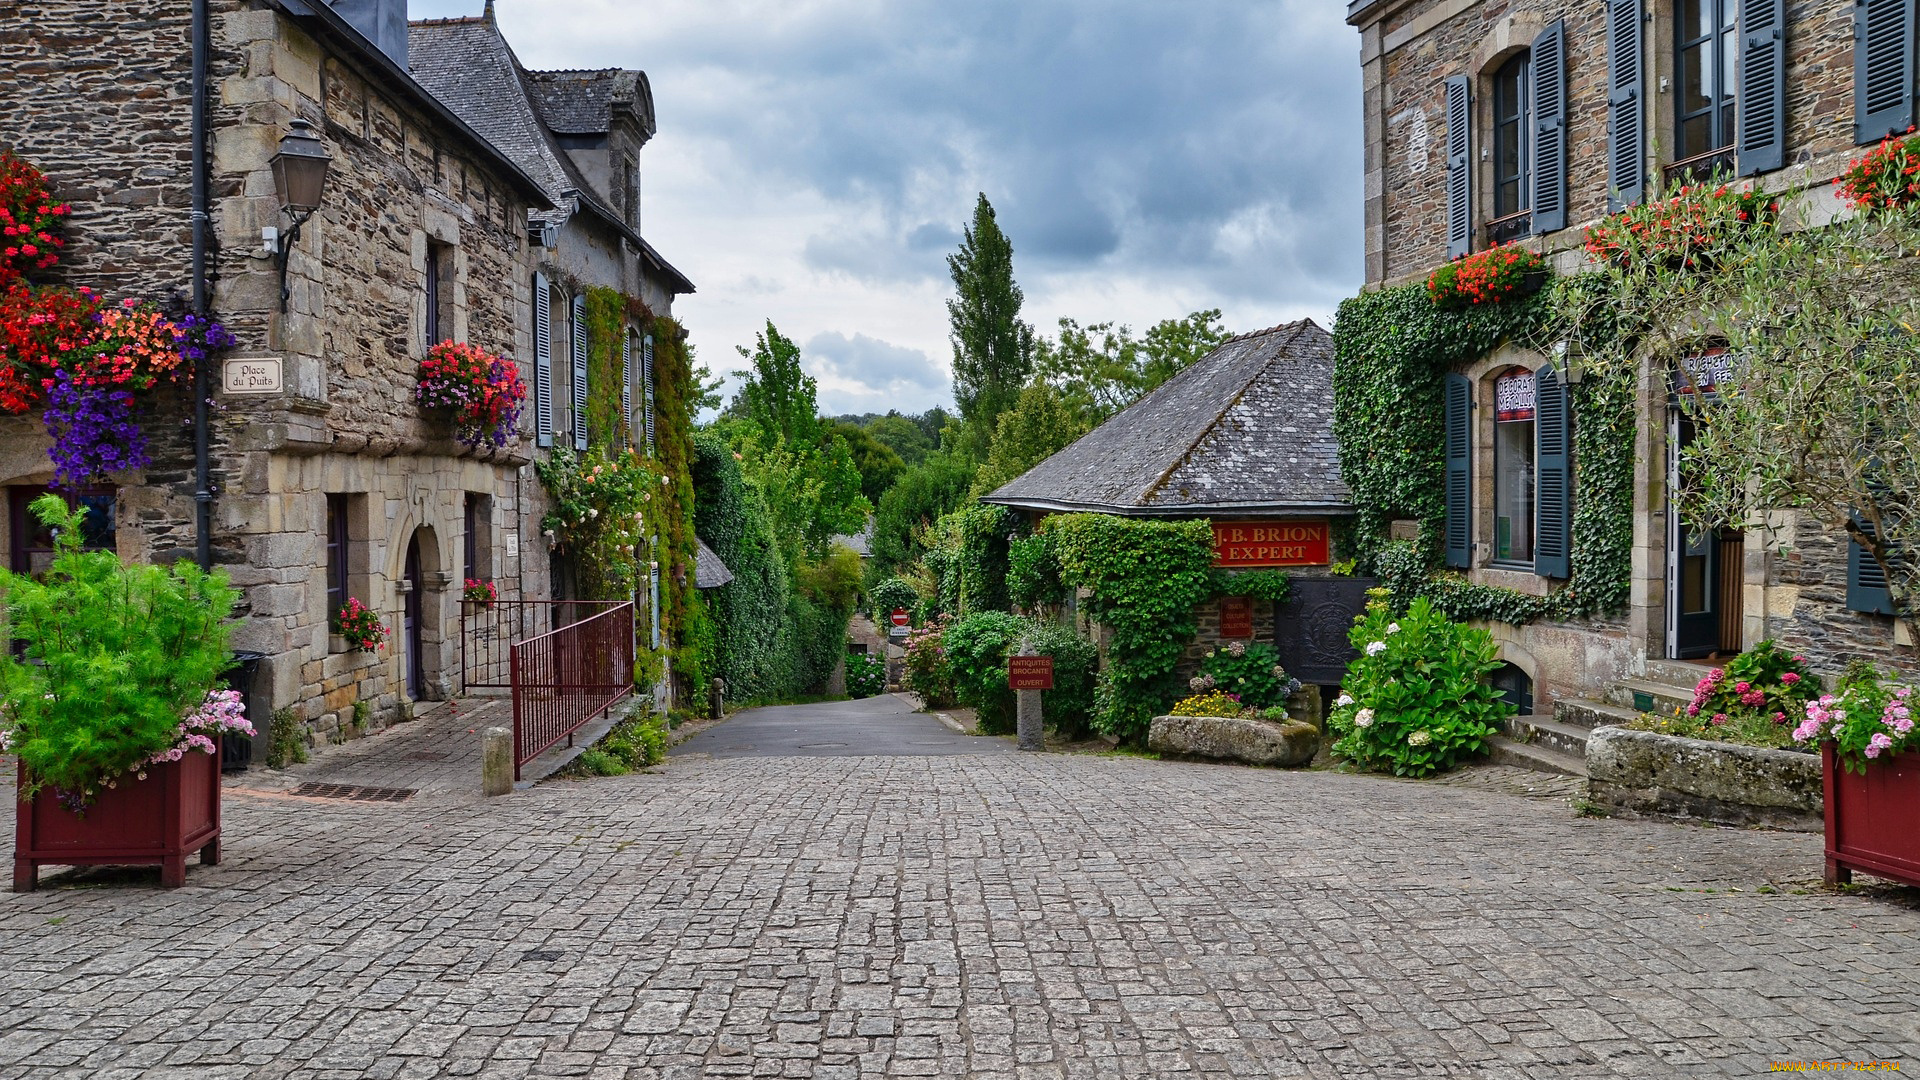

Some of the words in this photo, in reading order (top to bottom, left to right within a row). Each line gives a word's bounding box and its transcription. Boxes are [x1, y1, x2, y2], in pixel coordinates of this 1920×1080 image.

[240, 365, 265, 376] Place
[233, 377, 244, 386] du
[248, 376, 273, 388] Puits
[1216, 528, 1228, 548] J.
[1231, 528, 1248, 543] B.
[1252, 527, 1321, 542] BRION
[1228, 546, 1307, 560] EXPERT
[1013, 667, 1050, 675] BROCANTE
